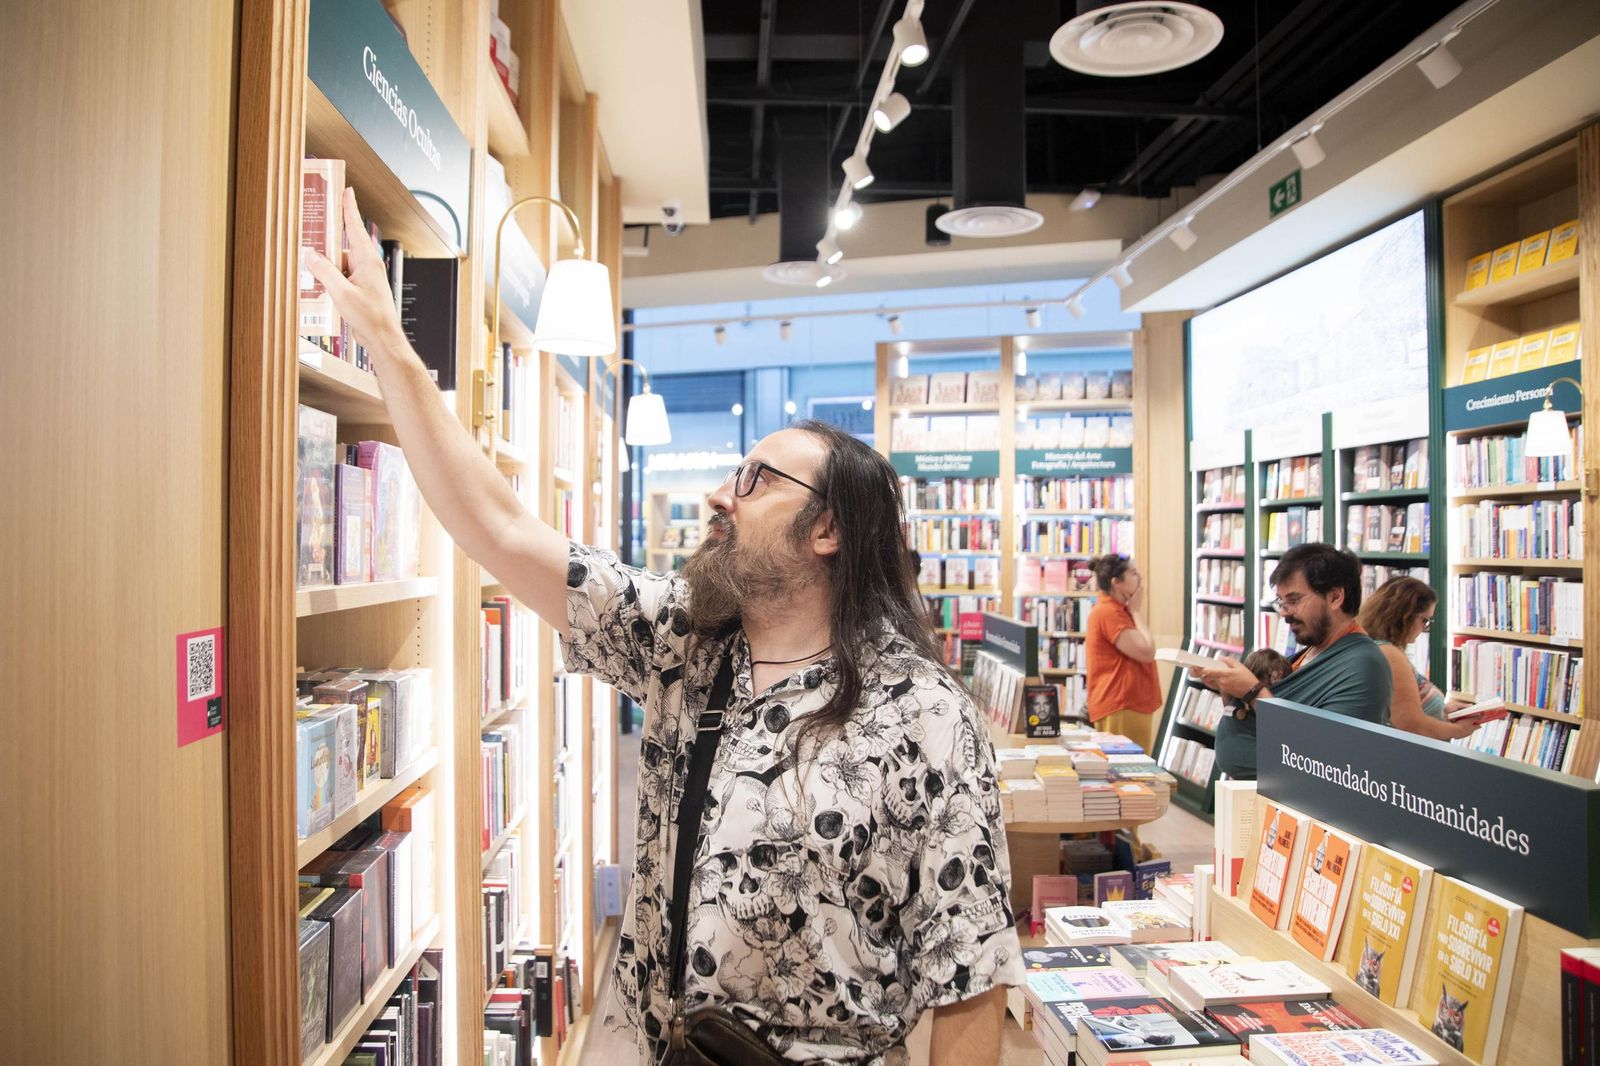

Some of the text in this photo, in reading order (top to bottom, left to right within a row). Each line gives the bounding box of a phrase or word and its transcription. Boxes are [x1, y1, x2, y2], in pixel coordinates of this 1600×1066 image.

[363, 46, 441, 172] Ciencias Ocultas
[1466, 394, 1515, 411] Crecimiento
[1031, 461, 1067, 471] Fotografía
[1071, 461, 1116, 471] Arquitectura
[1045, 452, 1102, 461] Historia del Arte
[1281, 744, 1530, 856] Recomendados Humanidades
[1370, 876, 1402, 906] FILOSOFÍA
[1371, 892, 1406, 927] SOBREVIVIR
[1372, 911, 1389, 934] SIGLO
[1388, 924, 1400, 941] XXI
[1447, 914, 1488, 951] FILOSOFÍA
[1448, 934, 1494, 974] SOBREVIVIR
[1450, 954, 1472, 980] SIGLO
[1472, 968, 1487, 990] XXI
[1298, 1002, 1319, 1016] DAN
[1312, 1012, 1343, 1031] JONE
